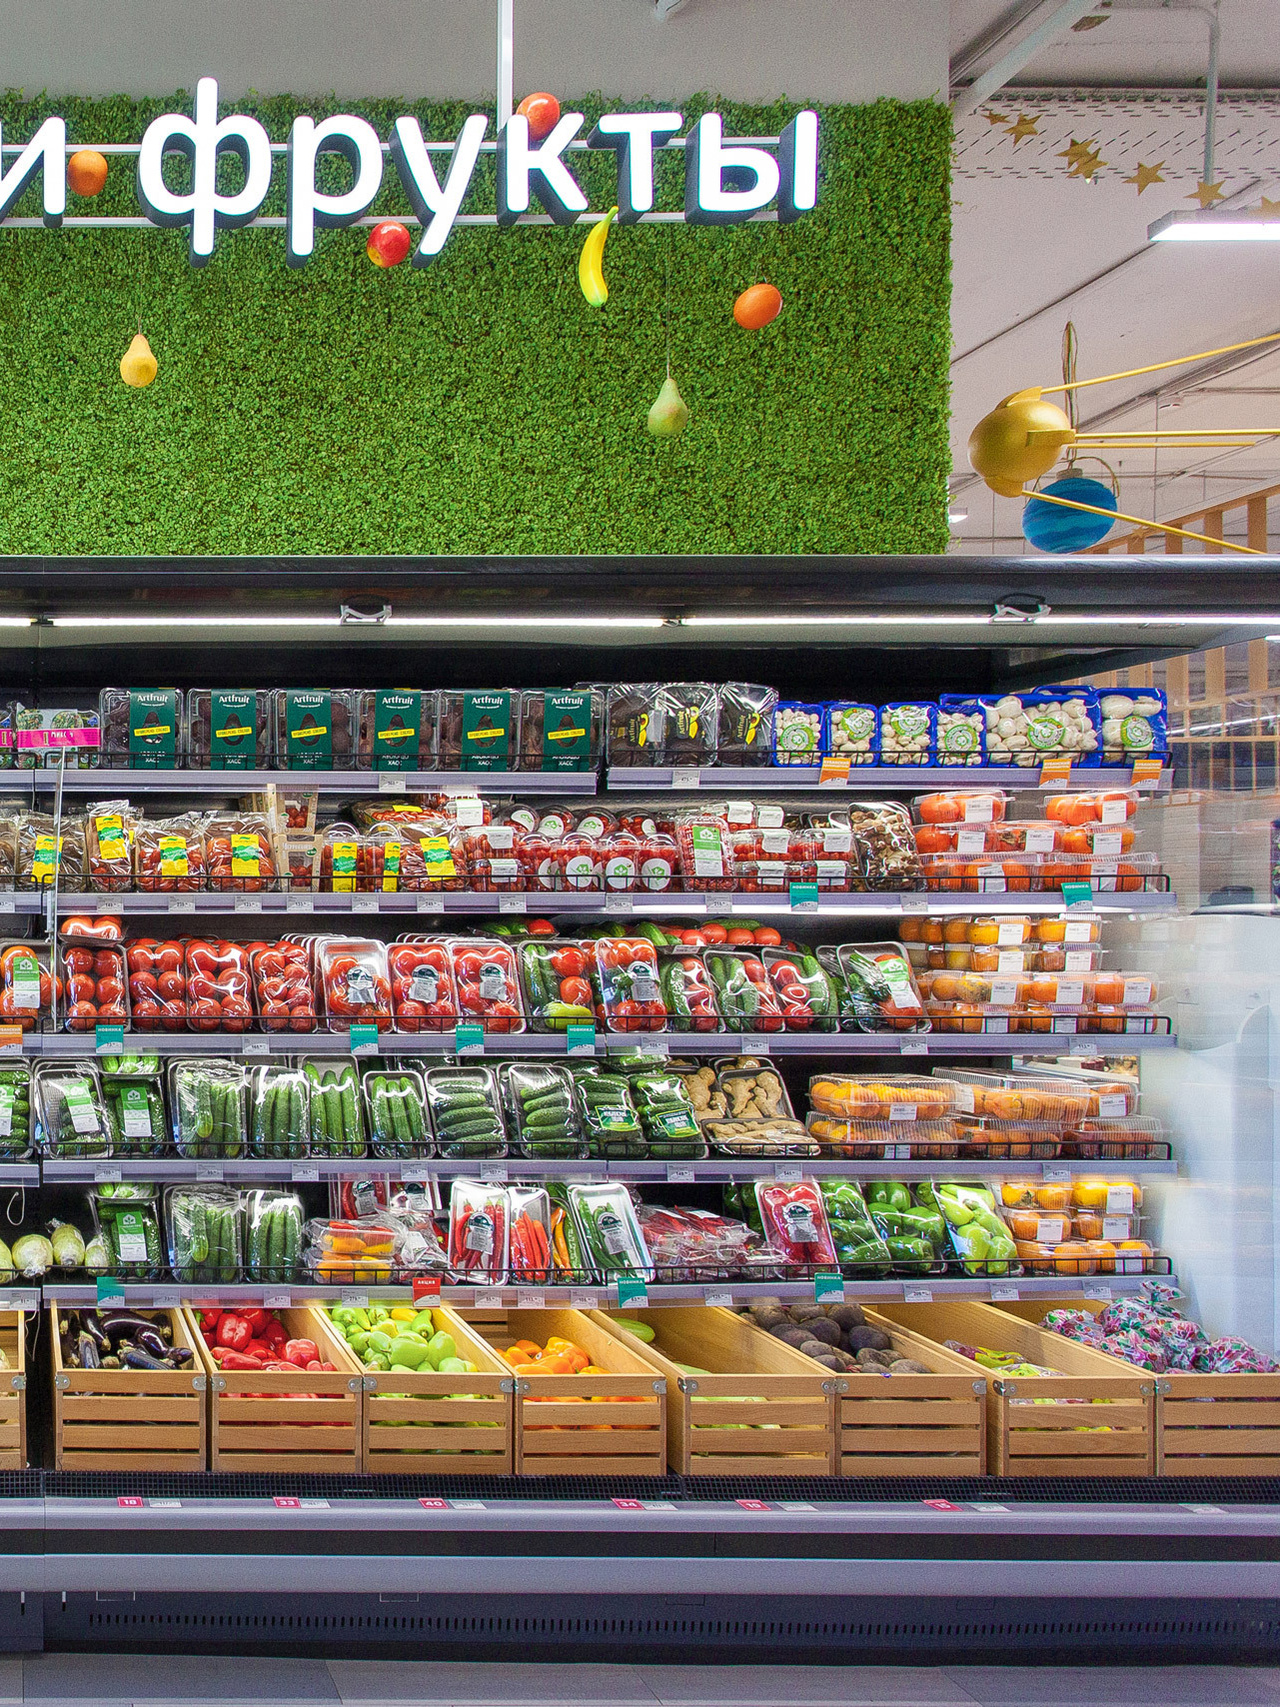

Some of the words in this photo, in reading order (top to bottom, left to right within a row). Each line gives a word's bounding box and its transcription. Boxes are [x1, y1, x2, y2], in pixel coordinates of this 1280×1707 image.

[138, 78, 820, 257] фрукты
[137, 694, 168, 703] Artfruit
[219, 695, 250, 704] Artfruit
[293, 695, 324, 704] Artfruit
[382, 696, 413, 705] Artfruit
[471, 696, 503, 705] Artfruit
[551, 696, 583, 705] Artfruit
